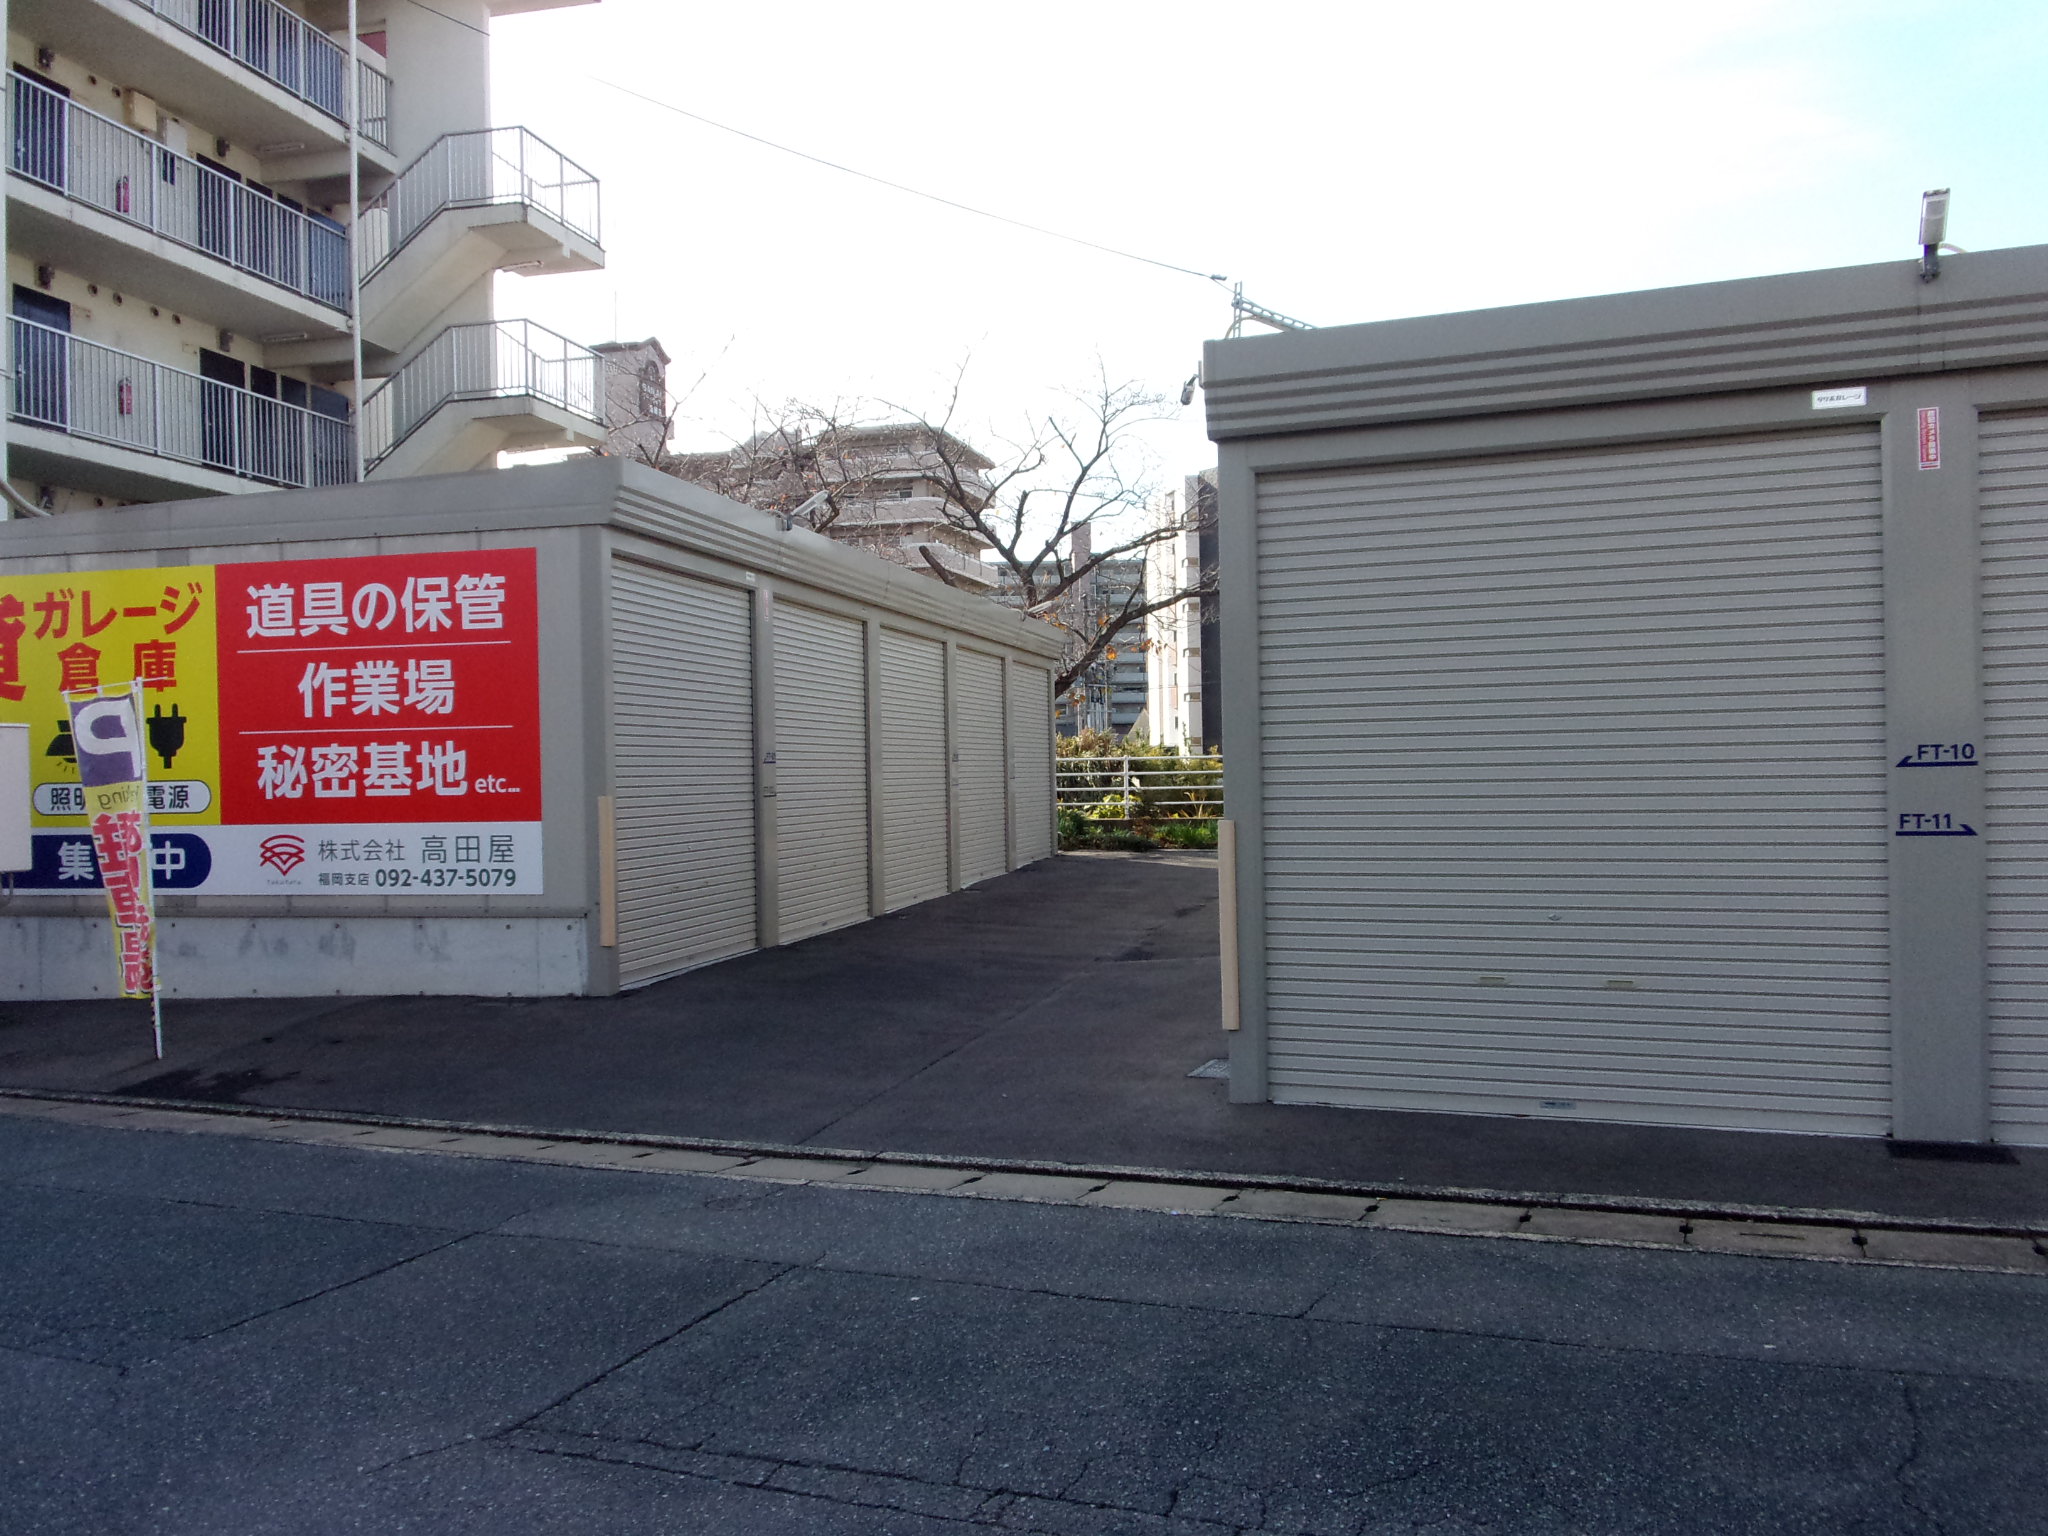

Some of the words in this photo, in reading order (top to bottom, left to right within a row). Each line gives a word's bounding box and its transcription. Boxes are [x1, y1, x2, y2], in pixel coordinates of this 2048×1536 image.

[33, 581, 203, 640] ガレージ
[246, 573, 507, 639] 道具の保管
[57, 639, 177, 695] 倉庫
[297, 659, 457, 718] 作業場
[257, 741, 469, 800] 秘密基地
[1917, 743, 1975, 760] FT-10
[318, 839, 406, 862] 株式会社
[421, 834, 515, 864] 高田屋
[1899, 813, 1952, 829] FT-11
[318, 873, 369, 886] 福岡支店
[375, 868, 517, 887] 092-437-5079
